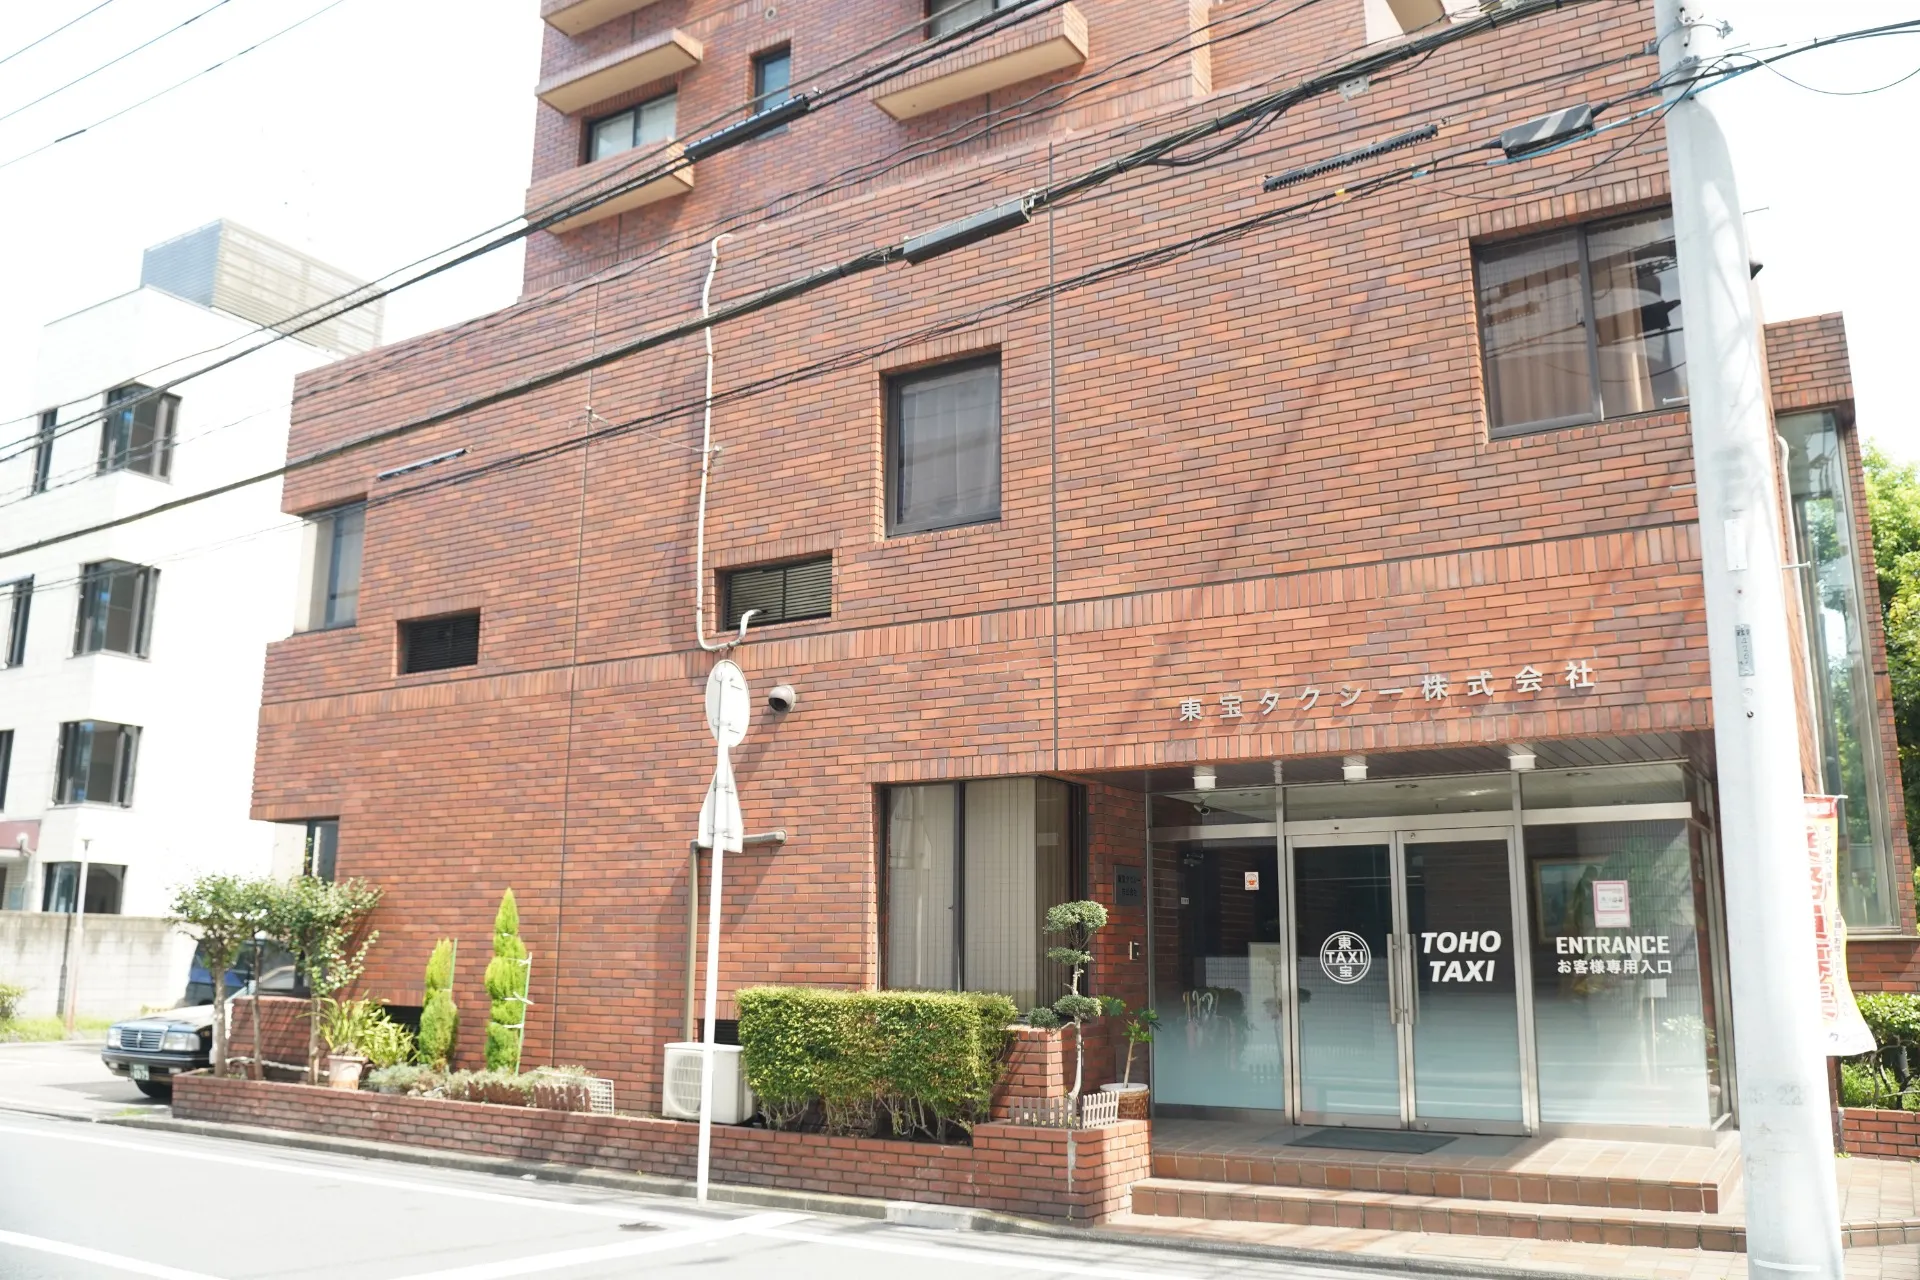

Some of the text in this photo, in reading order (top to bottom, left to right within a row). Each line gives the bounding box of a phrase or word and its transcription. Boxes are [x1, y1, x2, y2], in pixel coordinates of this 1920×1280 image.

[1179, 660, 1595, 722] 東宝タクシー株式会社
[1338, 935, 1351, 950] 東
[1421, 930, 1502, 954] TOHO
[1556, 936, 1670, 954] ENTRANCE
[1326, 951, 1364, 964] TAXI
[1339, 965, 1353, 978] 宝
[1430, 960, 1496, 982] TAXI
[1557, 959, 1673, 974] お客様専用入口
